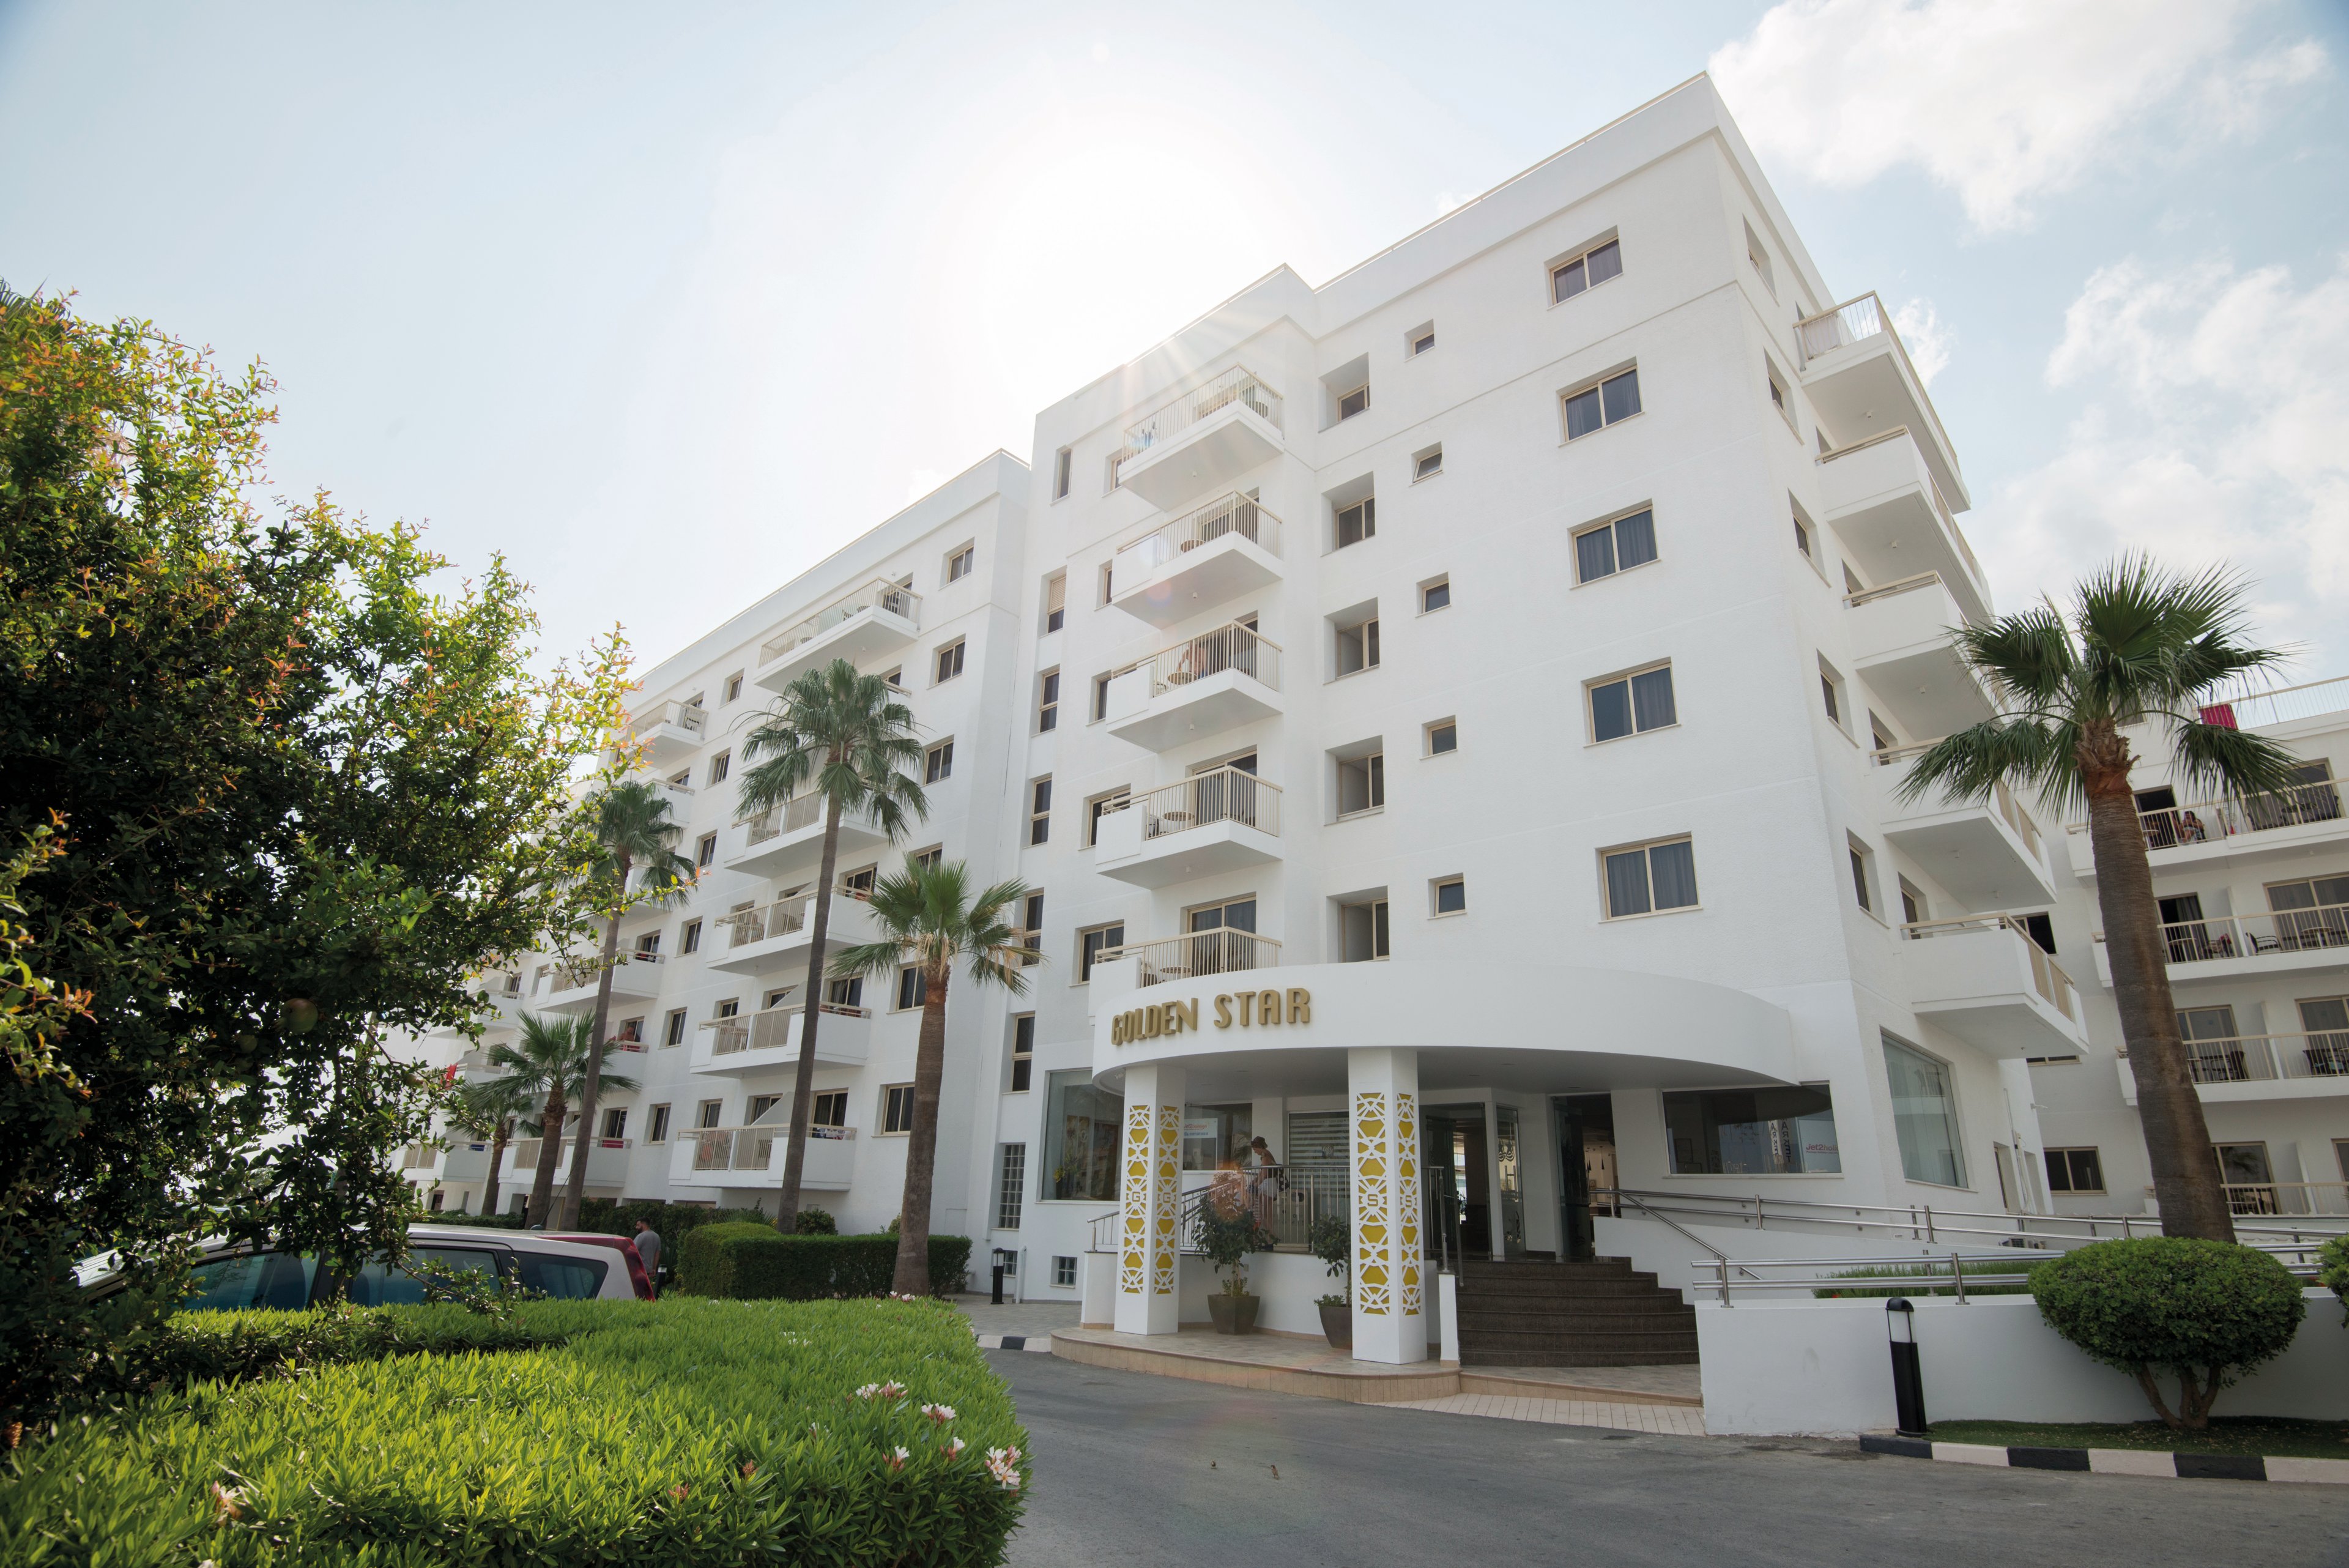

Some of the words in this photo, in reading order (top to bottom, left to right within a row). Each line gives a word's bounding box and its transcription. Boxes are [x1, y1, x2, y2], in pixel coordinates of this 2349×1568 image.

[1111, 998, 1198, 1046] GOLDEN
[1214, 987, 1310, 1028] STAR
[1132, 1192, 1140, 1202] G
[1163, 1192, 1170, 1203] G
[1368, 1194, 1378, 1206] S
[1406, 1195, 1412, 1208] S
